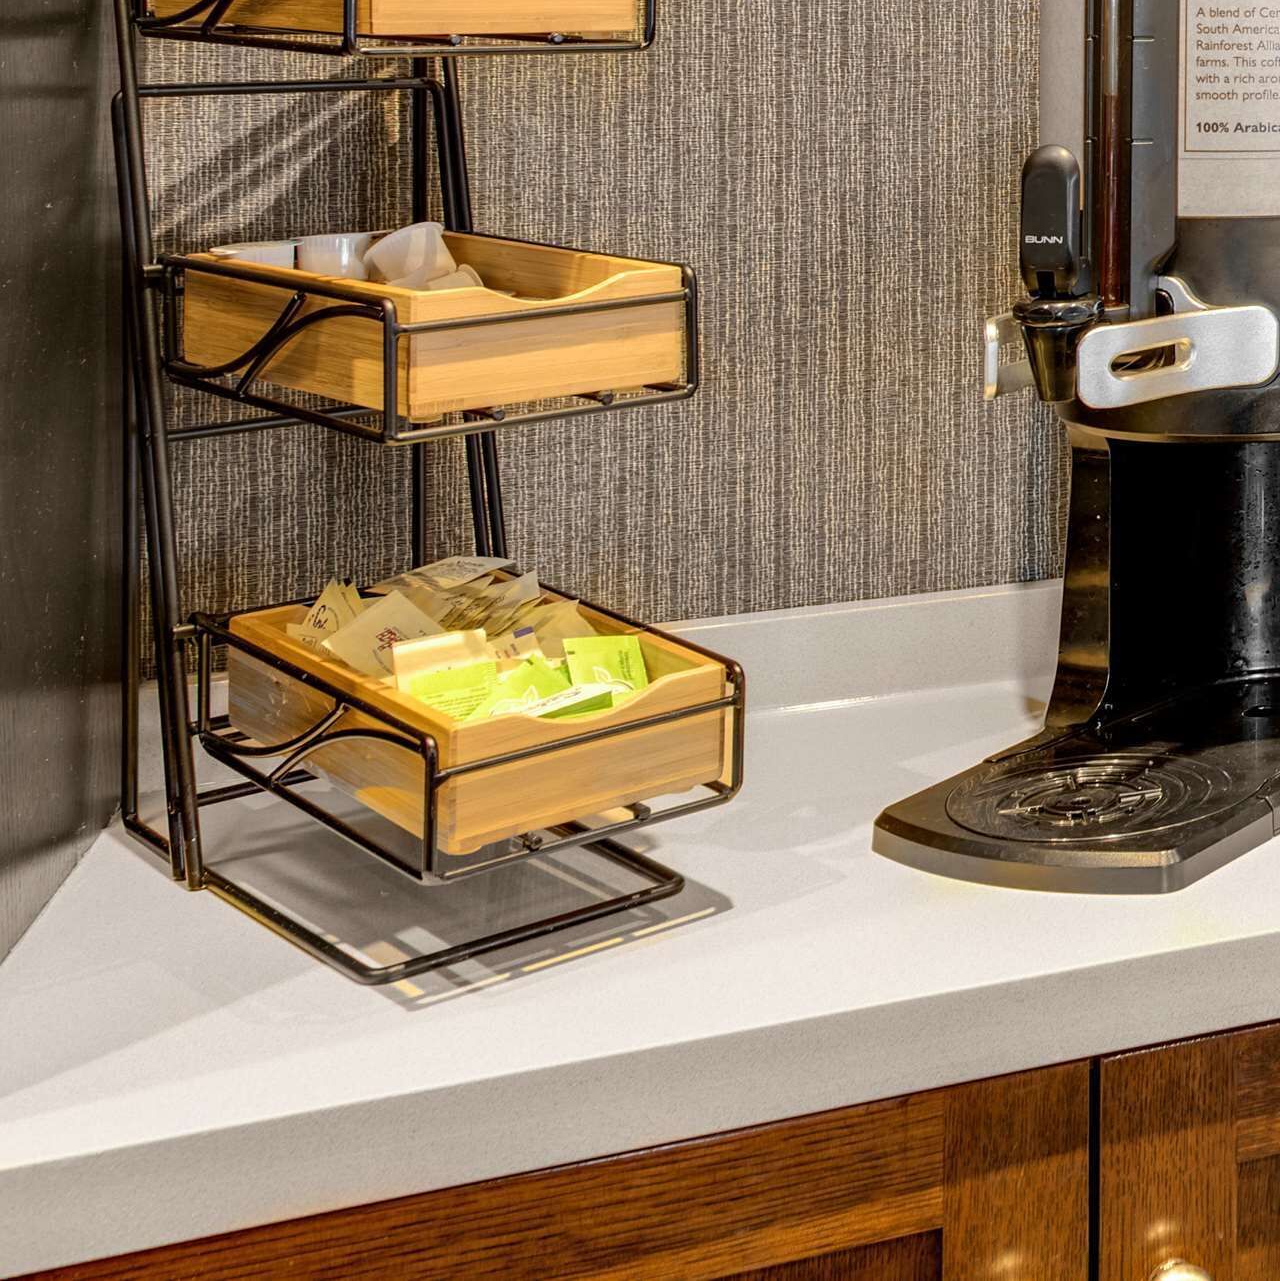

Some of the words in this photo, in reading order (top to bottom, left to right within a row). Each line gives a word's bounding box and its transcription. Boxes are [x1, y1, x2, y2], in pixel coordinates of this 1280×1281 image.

[1196, 9, 1205, 18] A
[1210, 7, 1239, 18] blend
[1244, 7, 1256, 18] of
[1196, 24, 1228, 34] South
[1196, 40, 1253, 51] Rainforest
[1196, 57, 1229, 67] farms.
[1233, 57, 1256, 67] This
[1195, 73, 1220, 83] with
[1234, 73, 1254, 83] rich
[1195, 90, 1238, 100] smooth
[1196, 122, 1229, 133] 100%
[1025, 235, 1063, 244] BUNN
